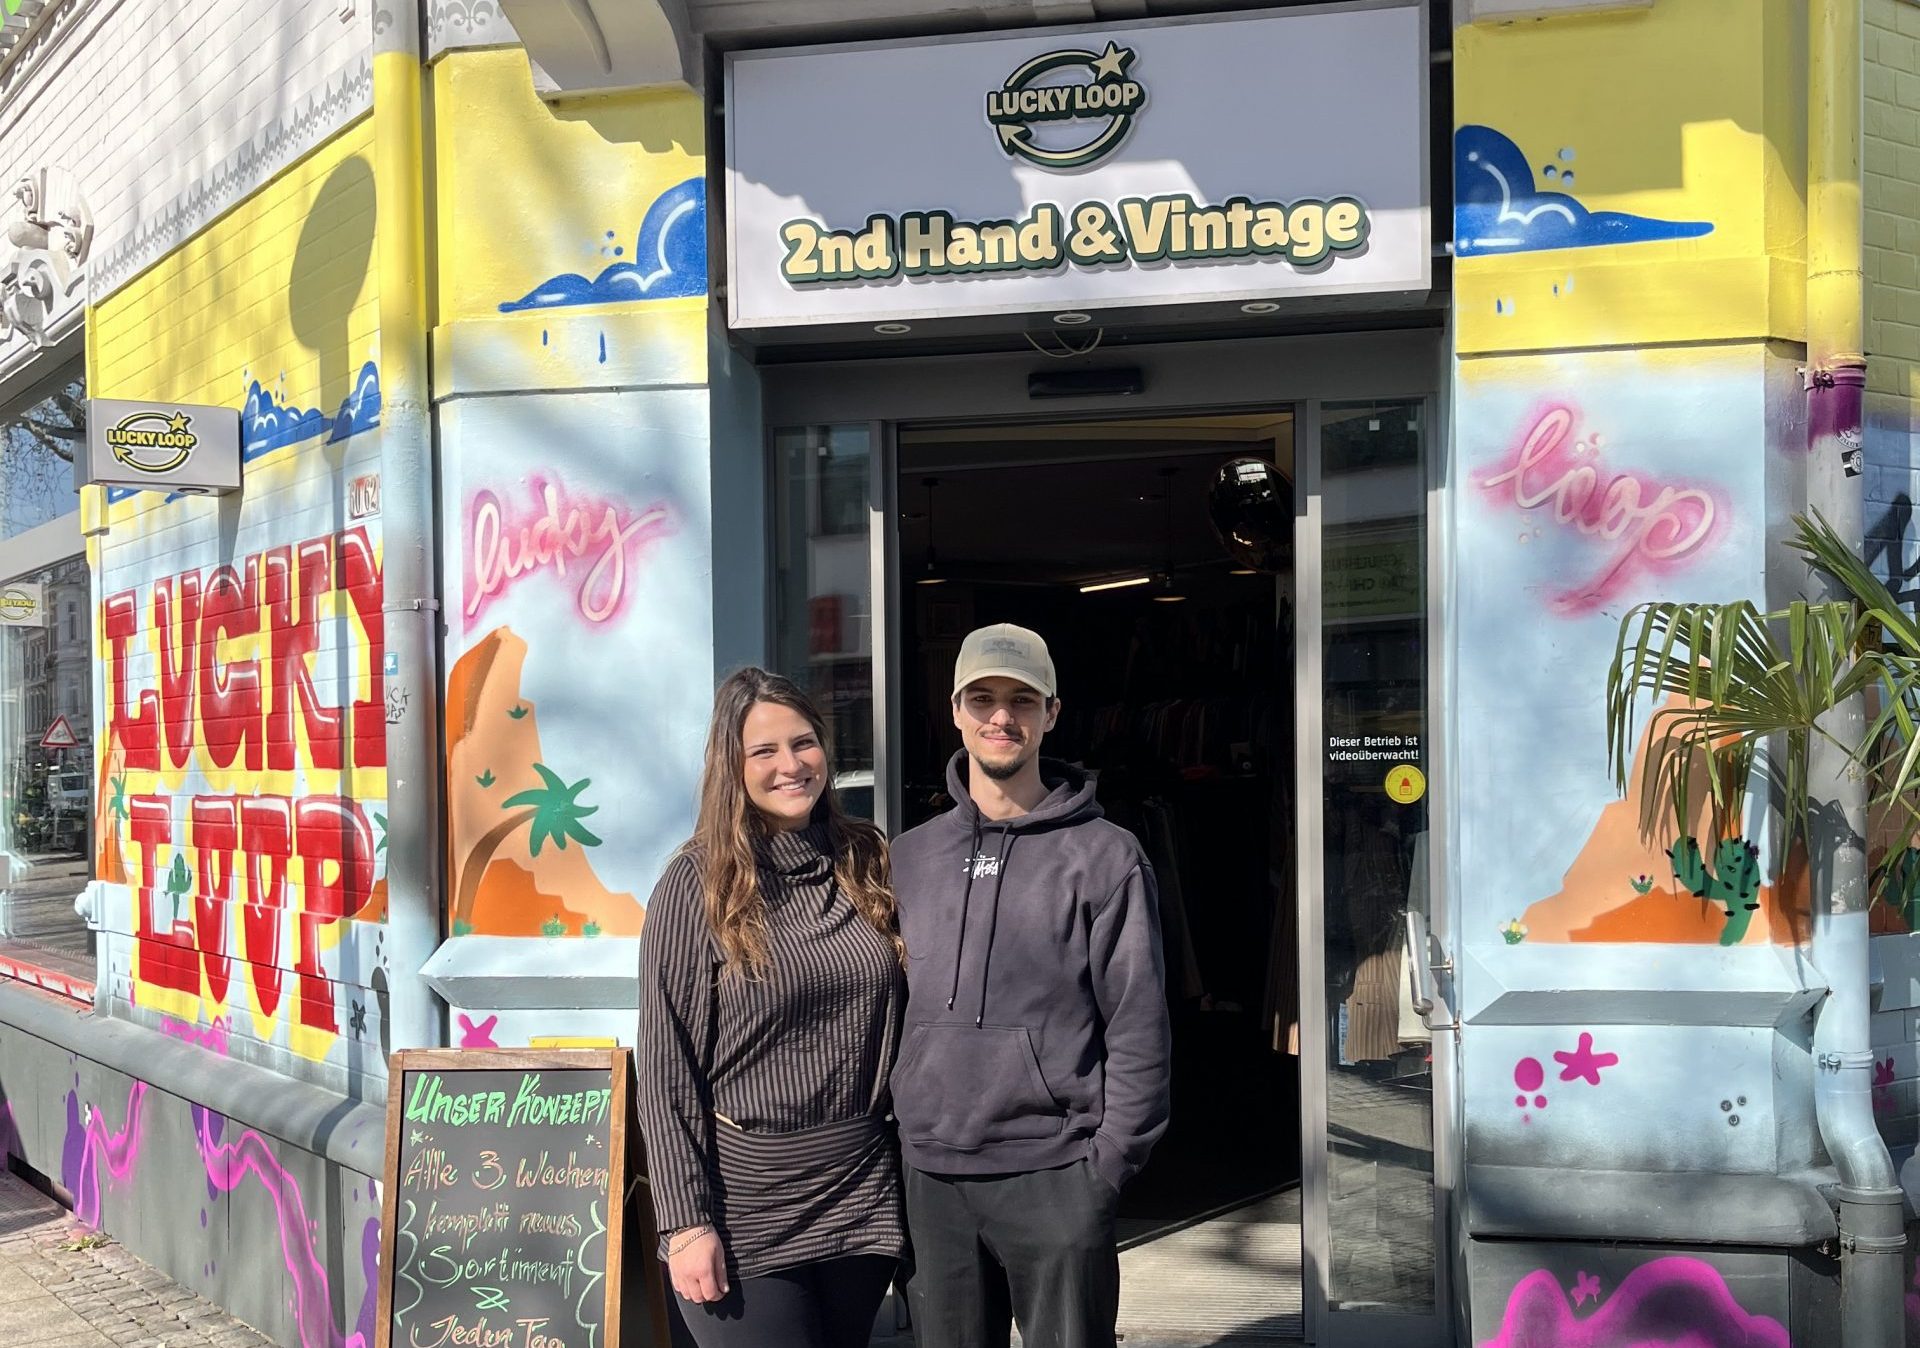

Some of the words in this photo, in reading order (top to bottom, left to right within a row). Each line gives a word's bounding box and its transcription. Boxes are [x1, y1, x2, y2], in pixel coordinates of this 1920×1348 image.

[988, 86, 1071, 118] LUCKY
[1073, 81, 1141, 112] LOOP
[784, 217, 893, 277] 2nd
[904, 207, 1057, 269] Hand
[1070, 205, 1122, 258] &
[1117, 197, 1363, 259] Vintage
[107, 429, 156, 446] LUCKY
[157, 432, 196, 448] LOOP
[105, 525, 387, 771] LUCKY
[1329, 736, 1361, 747] Dieser
[1364, 735, 1401, 746] Betrieb
[1404, 735, 1418, 746] ist
[1329, 749, 1419, 760] videoüberwacht!
[129, 794, 377, 1036] LOOP
[403, 1147, 459, 1194] Alle
[471, 1150, 508, 1190] 3
[515, 1150, 610, 1195] Wochen
[417, 1245, 575, 1300] Sortiment
[409, 1314, 514, 1348] Jeden
